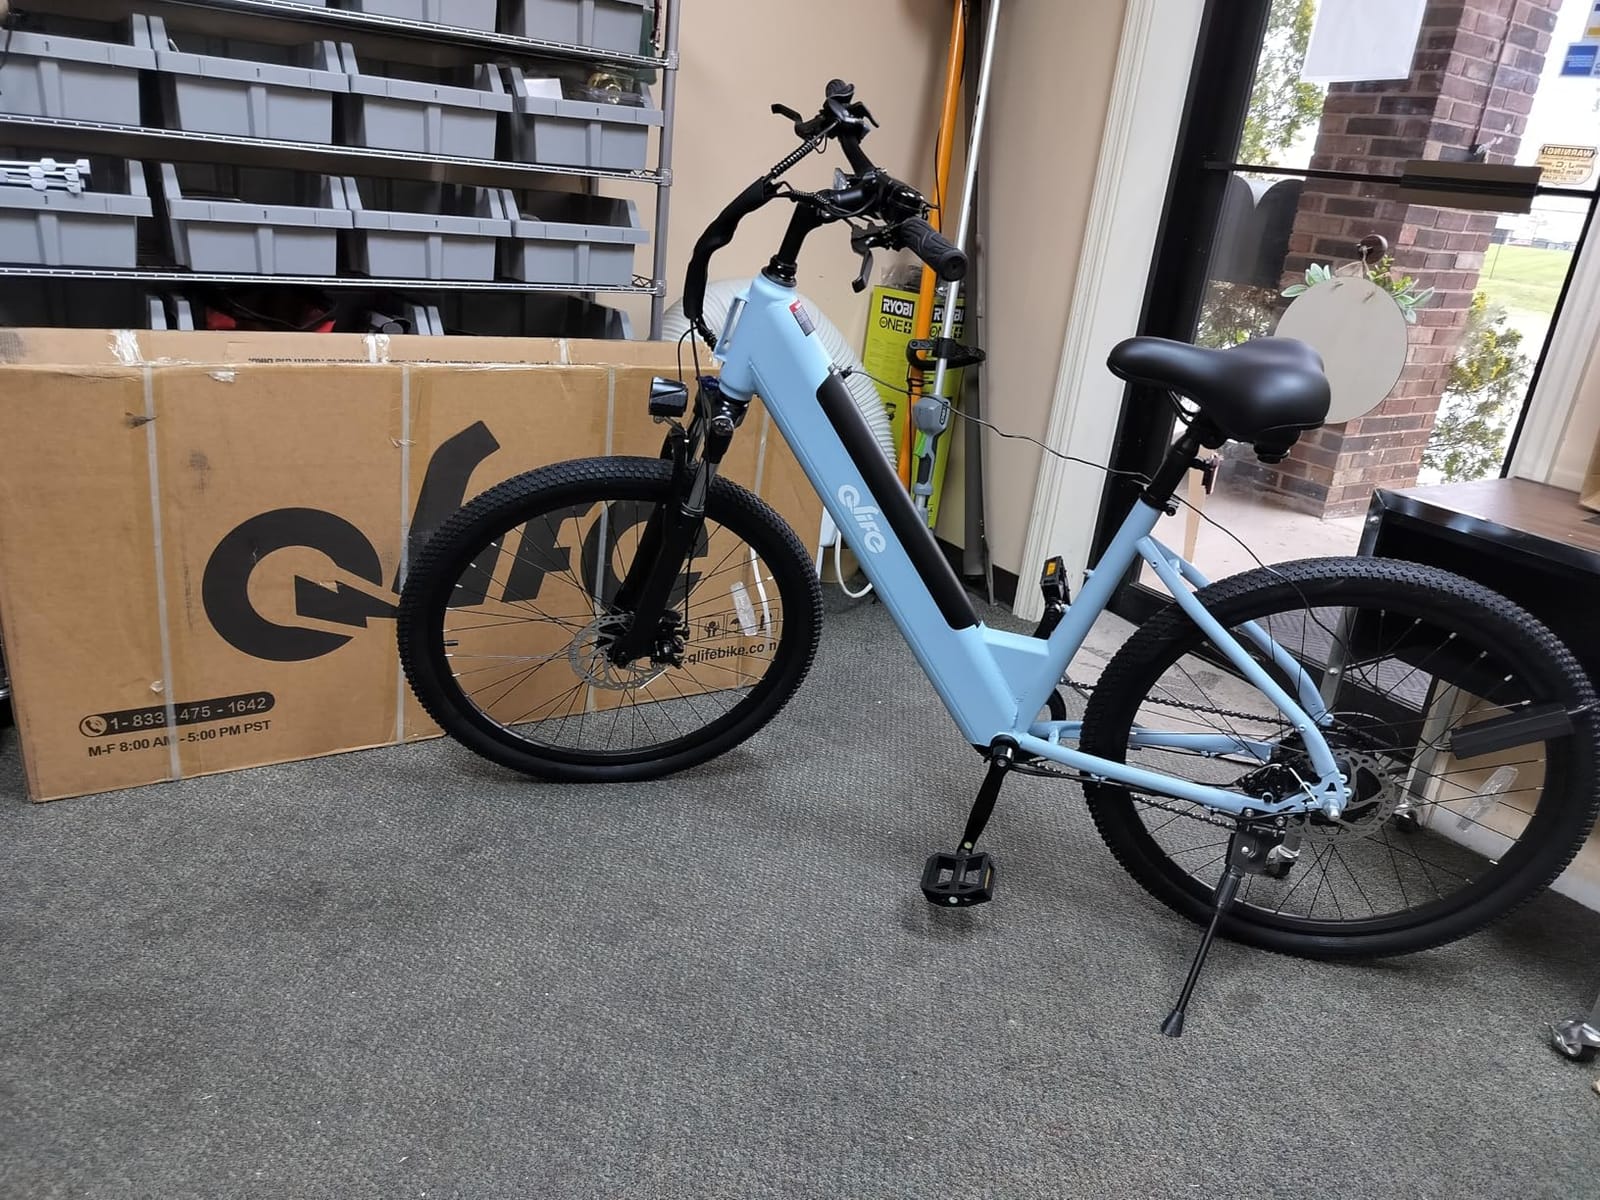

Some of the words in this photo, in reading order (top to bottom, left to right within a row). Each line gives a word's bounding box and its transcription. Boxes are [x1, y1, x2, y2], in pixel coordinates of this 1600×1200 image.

[881, 297, 914, 318] RYOBI
[933, 306, 965, 323] RBI
[87, 743, 116, 757] M-F
[119, 738, 150, 752] 8:00
[187, 728, 217, 743] 5:00
[219, 724, 241, 738] PM
[244, 719, 272, 734] PST
